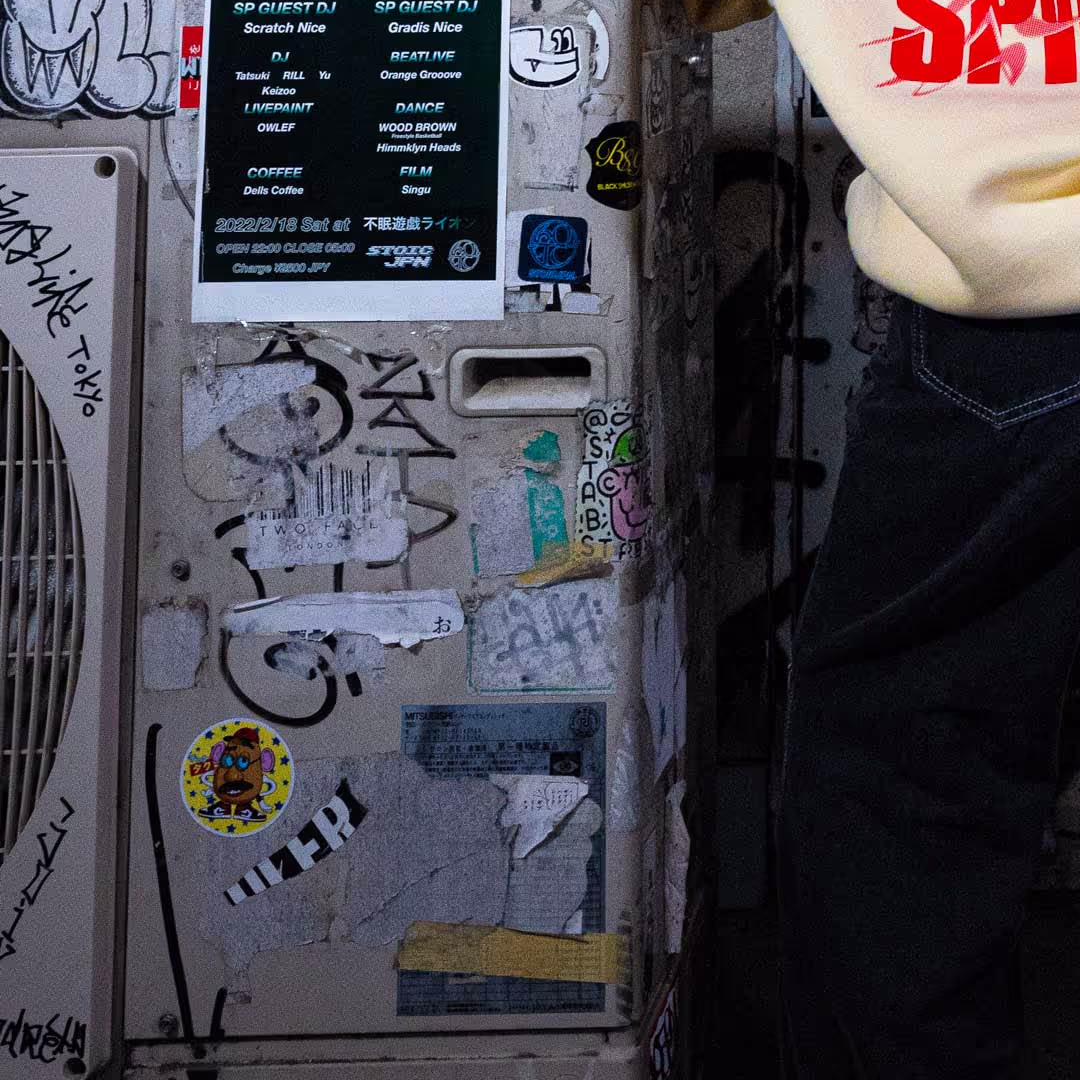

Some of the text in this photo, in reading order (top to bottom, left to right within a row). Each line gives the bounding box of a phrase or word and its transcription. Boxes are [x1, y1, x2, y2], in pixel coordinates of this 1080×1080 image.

[232, 0, 337, 16] SP GUEST DJ
[373, 0, 479, 14] SP GUEST DJ
[243, 21, 327, 34] Scratch Nice
[387, 21, 464, 34] Gradis Nice
[270, 51, 291, 63] DJ
[389, 50, 456, 63] BEATLIVE
[235, 70, 332, 81] Tatsuki RILL Yu
[379, 69, 463, 82] Orange Grooove
[261, 85, 297, 96] Keizoo
[243, 102, 315, 115] LIVEPAINT
[394, 102, 446, 114] DANCE
[256, 122, 297, 133] OWLEF
[378, 122, 458, 133] WOOD BROWN
[376, 142, 463, 155] Himmklyn Heads
[247, 166, 304, 179] COFFEE
[399, 165, 434, 177] FILM
[243, 185, 305, 196] Dells Coffee
[401, 184, 432, 196] Singu
[214, 216, 352, 233] 2022/2/18 Sat at
[215, 242, 251, 255] OPEN
[282, 242, 325, 254] CLOSE
[231, 262, 273, 276] Charge
[306, 261, 332, 273] JPY
[383, 256, 433, 269] JPN
[259, 523, 308, 538] TWO
[432, 616, 461, 634] お
